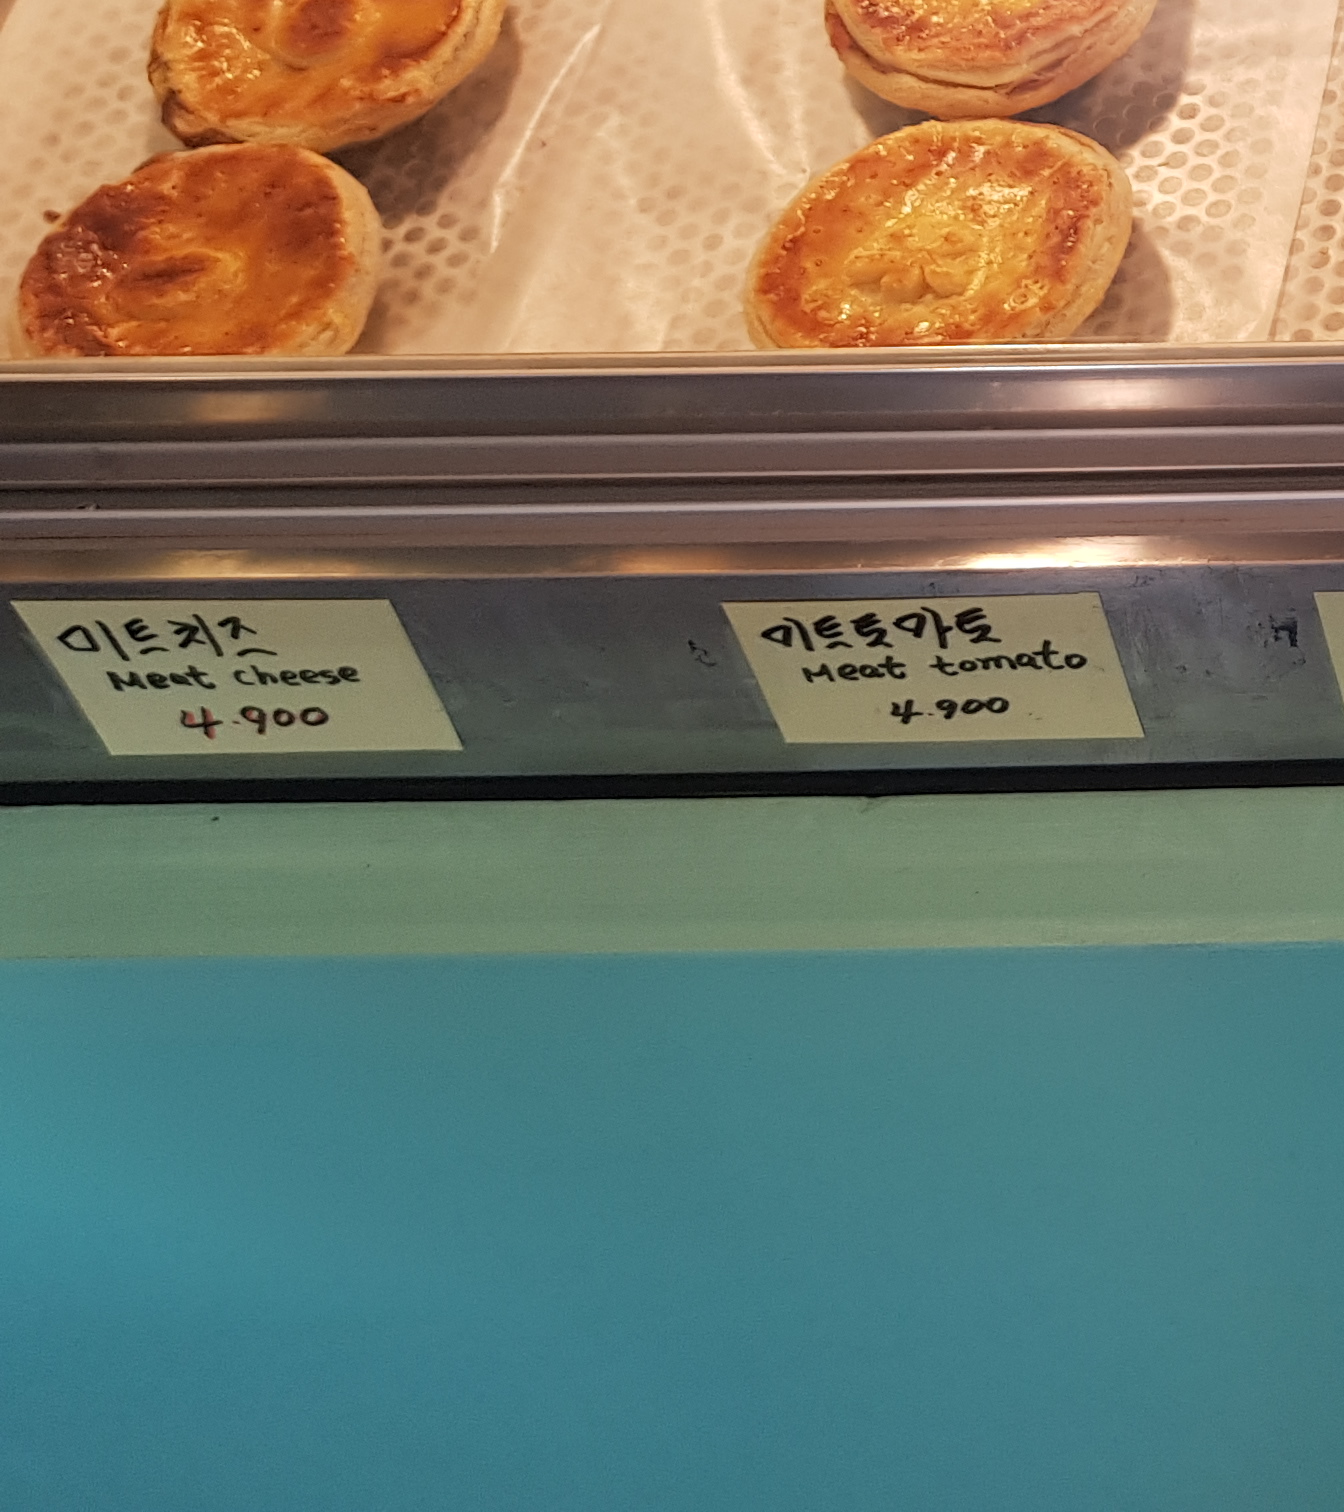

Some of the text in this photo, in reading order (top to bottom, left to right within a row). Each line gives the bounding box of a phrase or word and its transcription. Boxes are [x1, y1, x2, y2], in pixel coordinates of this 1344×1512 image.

[56, 614, 278, 662] 미트치즈
[760, 605, 1003, 652] 미트토마토
[106, 664, 217, 691] Meat
[801, 640, 1088, 684] Meat tomato
[180, 706, 330, 740] 4.900
[890, 696, 1010, 724] 4.900
